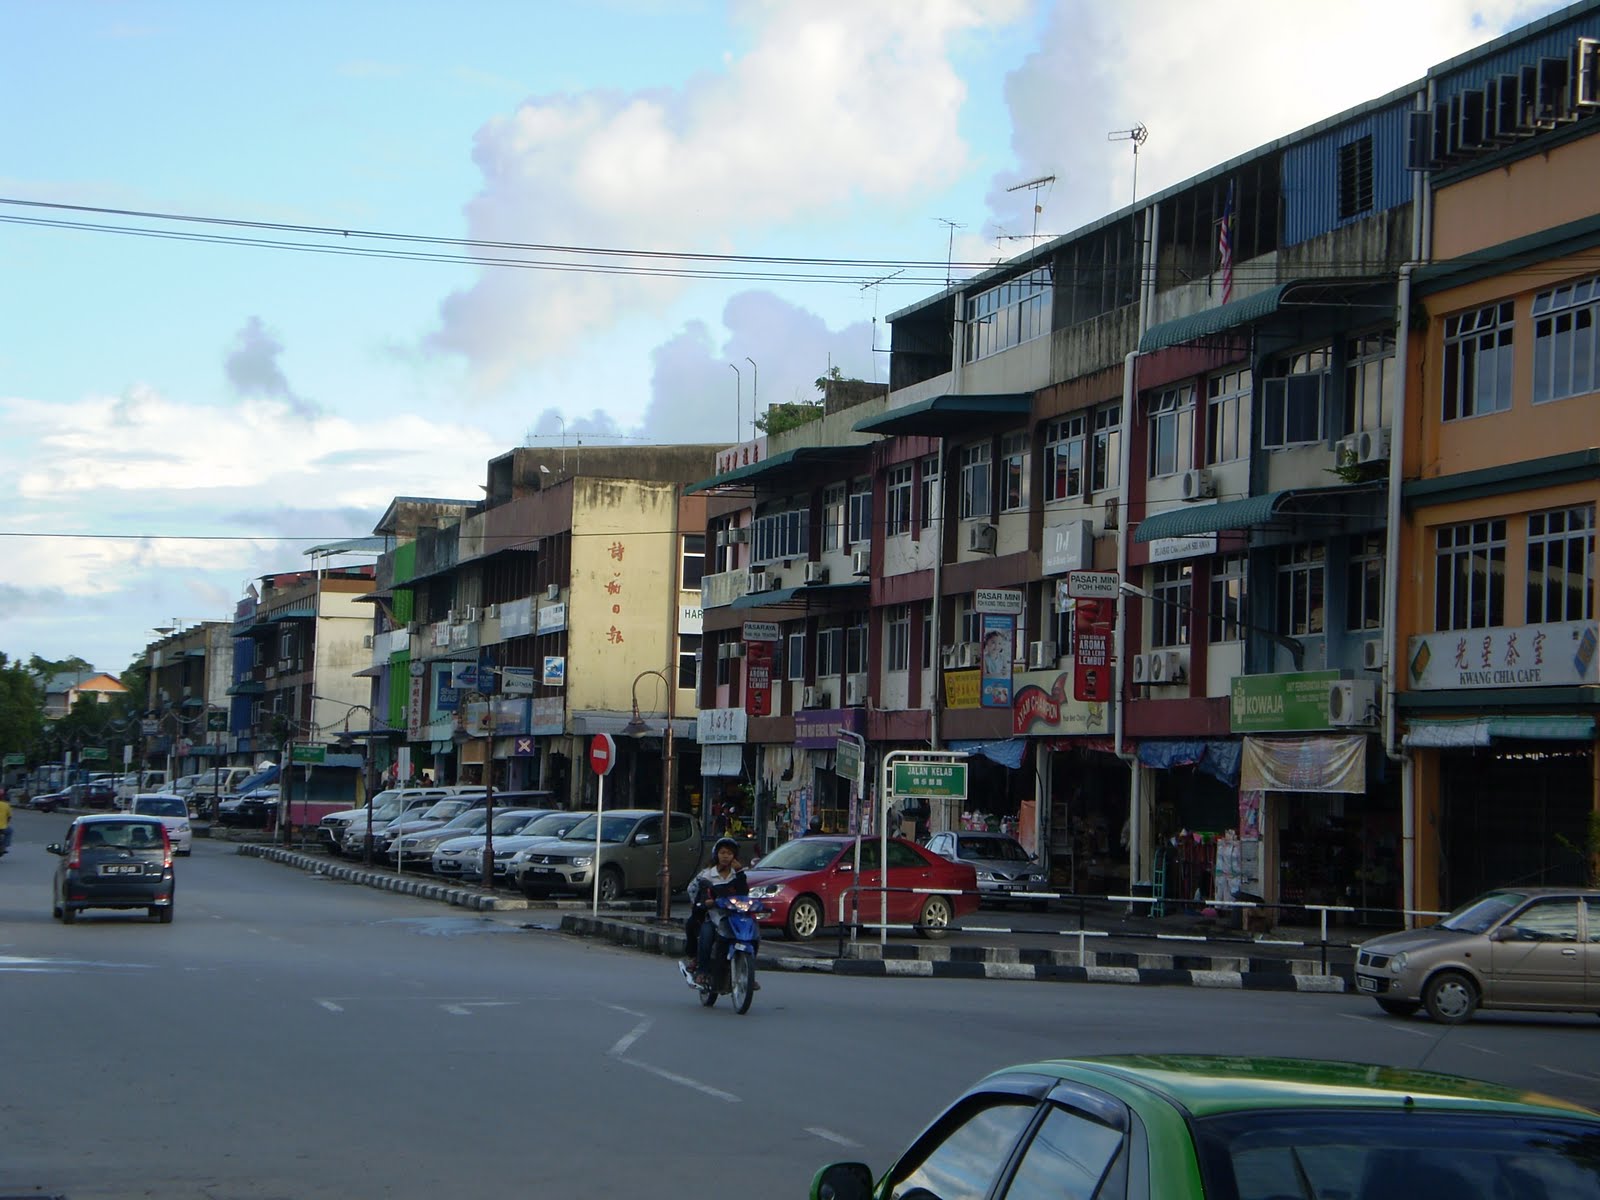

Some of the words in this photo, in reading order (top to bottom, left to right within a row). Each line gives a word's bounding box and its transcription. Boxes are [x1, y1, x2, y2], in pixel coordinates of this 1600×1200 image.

[1071, 575, 1098, 584] PASAR
[1100, 576, 1117, 585] MINI
[977, 592, 1003, 600] PASAR
[1004, 593, 1020, 601] MINI
[1079, 640, 1106, 650] AROMA
[1078, 656, 1105, 666] LEMBUT
[1459, 670, 1491, 685] KWANG
[1493, 670, 1516, 684] CHIA
[1517, 668, 1542, 683] CAFE
[440, 694, 457, 702] GAS
[1246, 694, 1285, 715] KOWAJA
[1017, 697, 1031, 731] AYAM
[907, 767, 928, 776] JALAN
[931, 767, 953, 777] KELAB
